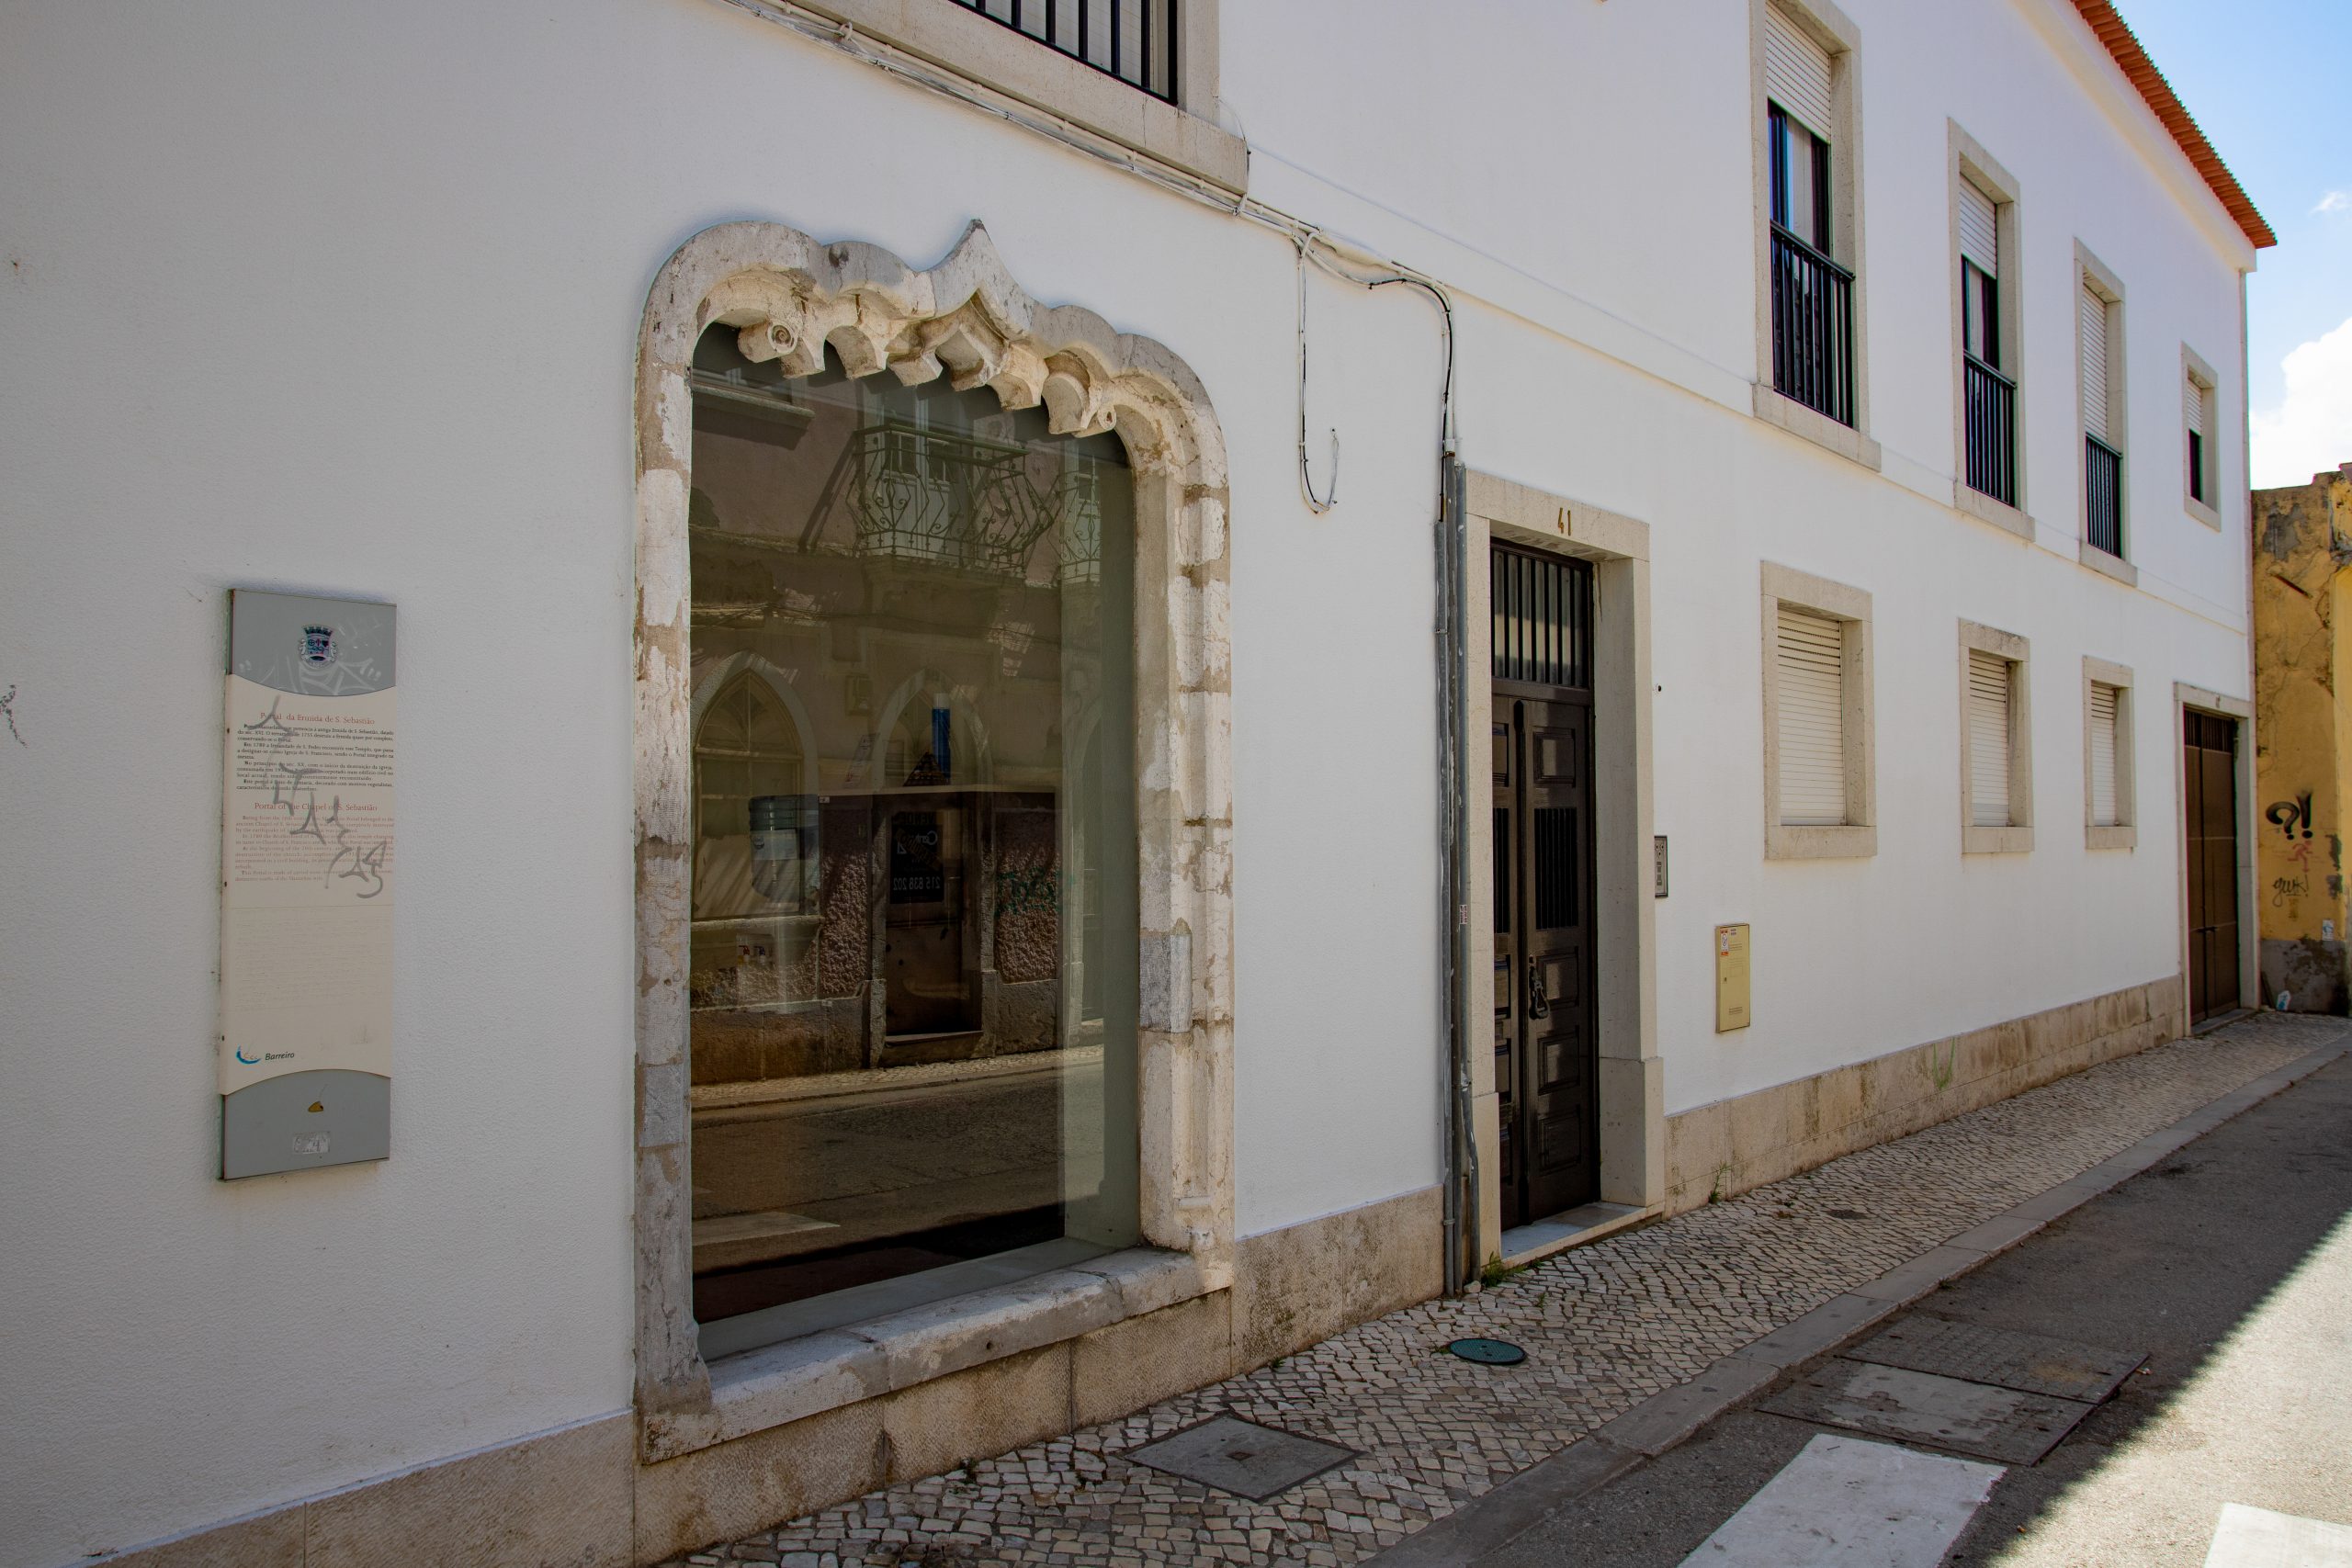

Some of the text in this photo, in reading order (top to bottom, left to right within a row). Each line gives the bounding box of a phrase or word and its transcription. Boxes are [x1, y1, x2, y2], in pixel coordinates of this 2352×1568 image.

[1557, 507, 1571, 536] 41
[261, 712, 282, 720] Ptal
[344, 716, 375, 725] Sebastião
[254, 802, 277, 810] Portal
[302, 803, 326, 813] Chpel
[265, 1051, 294, 1061] Barreiro
